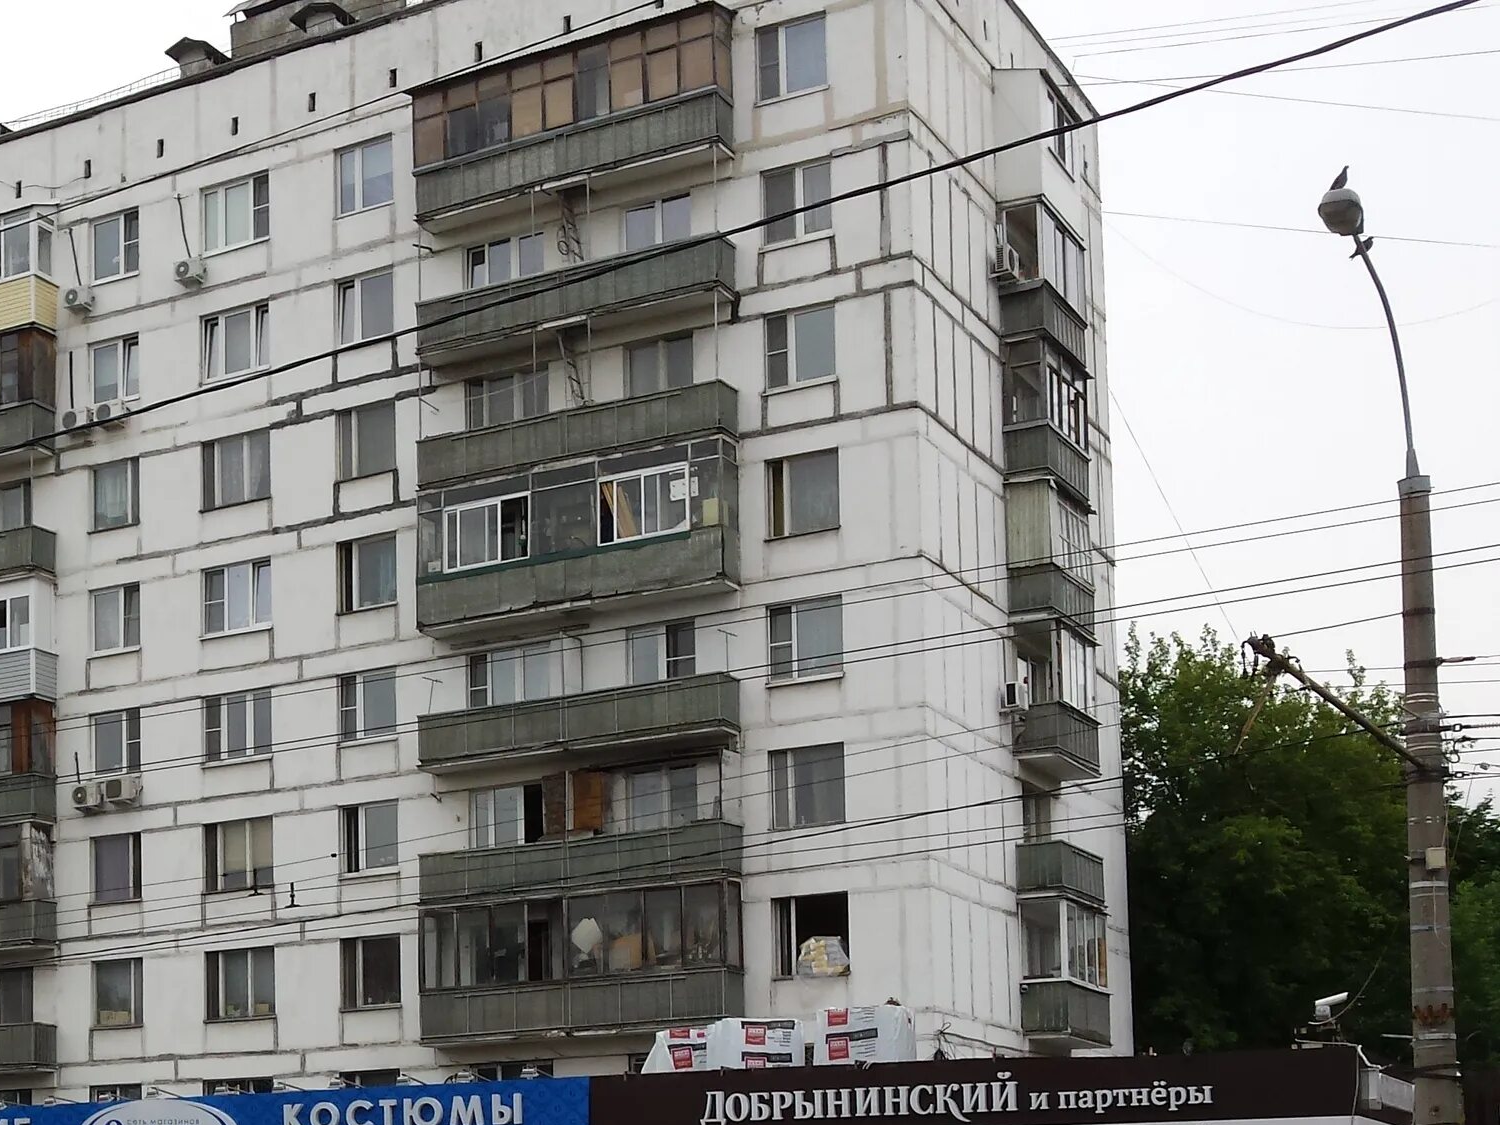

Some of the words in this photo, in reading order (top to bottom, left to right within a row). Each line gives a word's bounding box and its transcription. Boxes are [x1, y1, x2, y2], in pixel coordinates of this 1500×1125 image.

[1029, 1091, 1050, 1111] и
[1058, 1081, 1214, 1114] партнёры
[150, 1118, 200, 1125] магазинов
